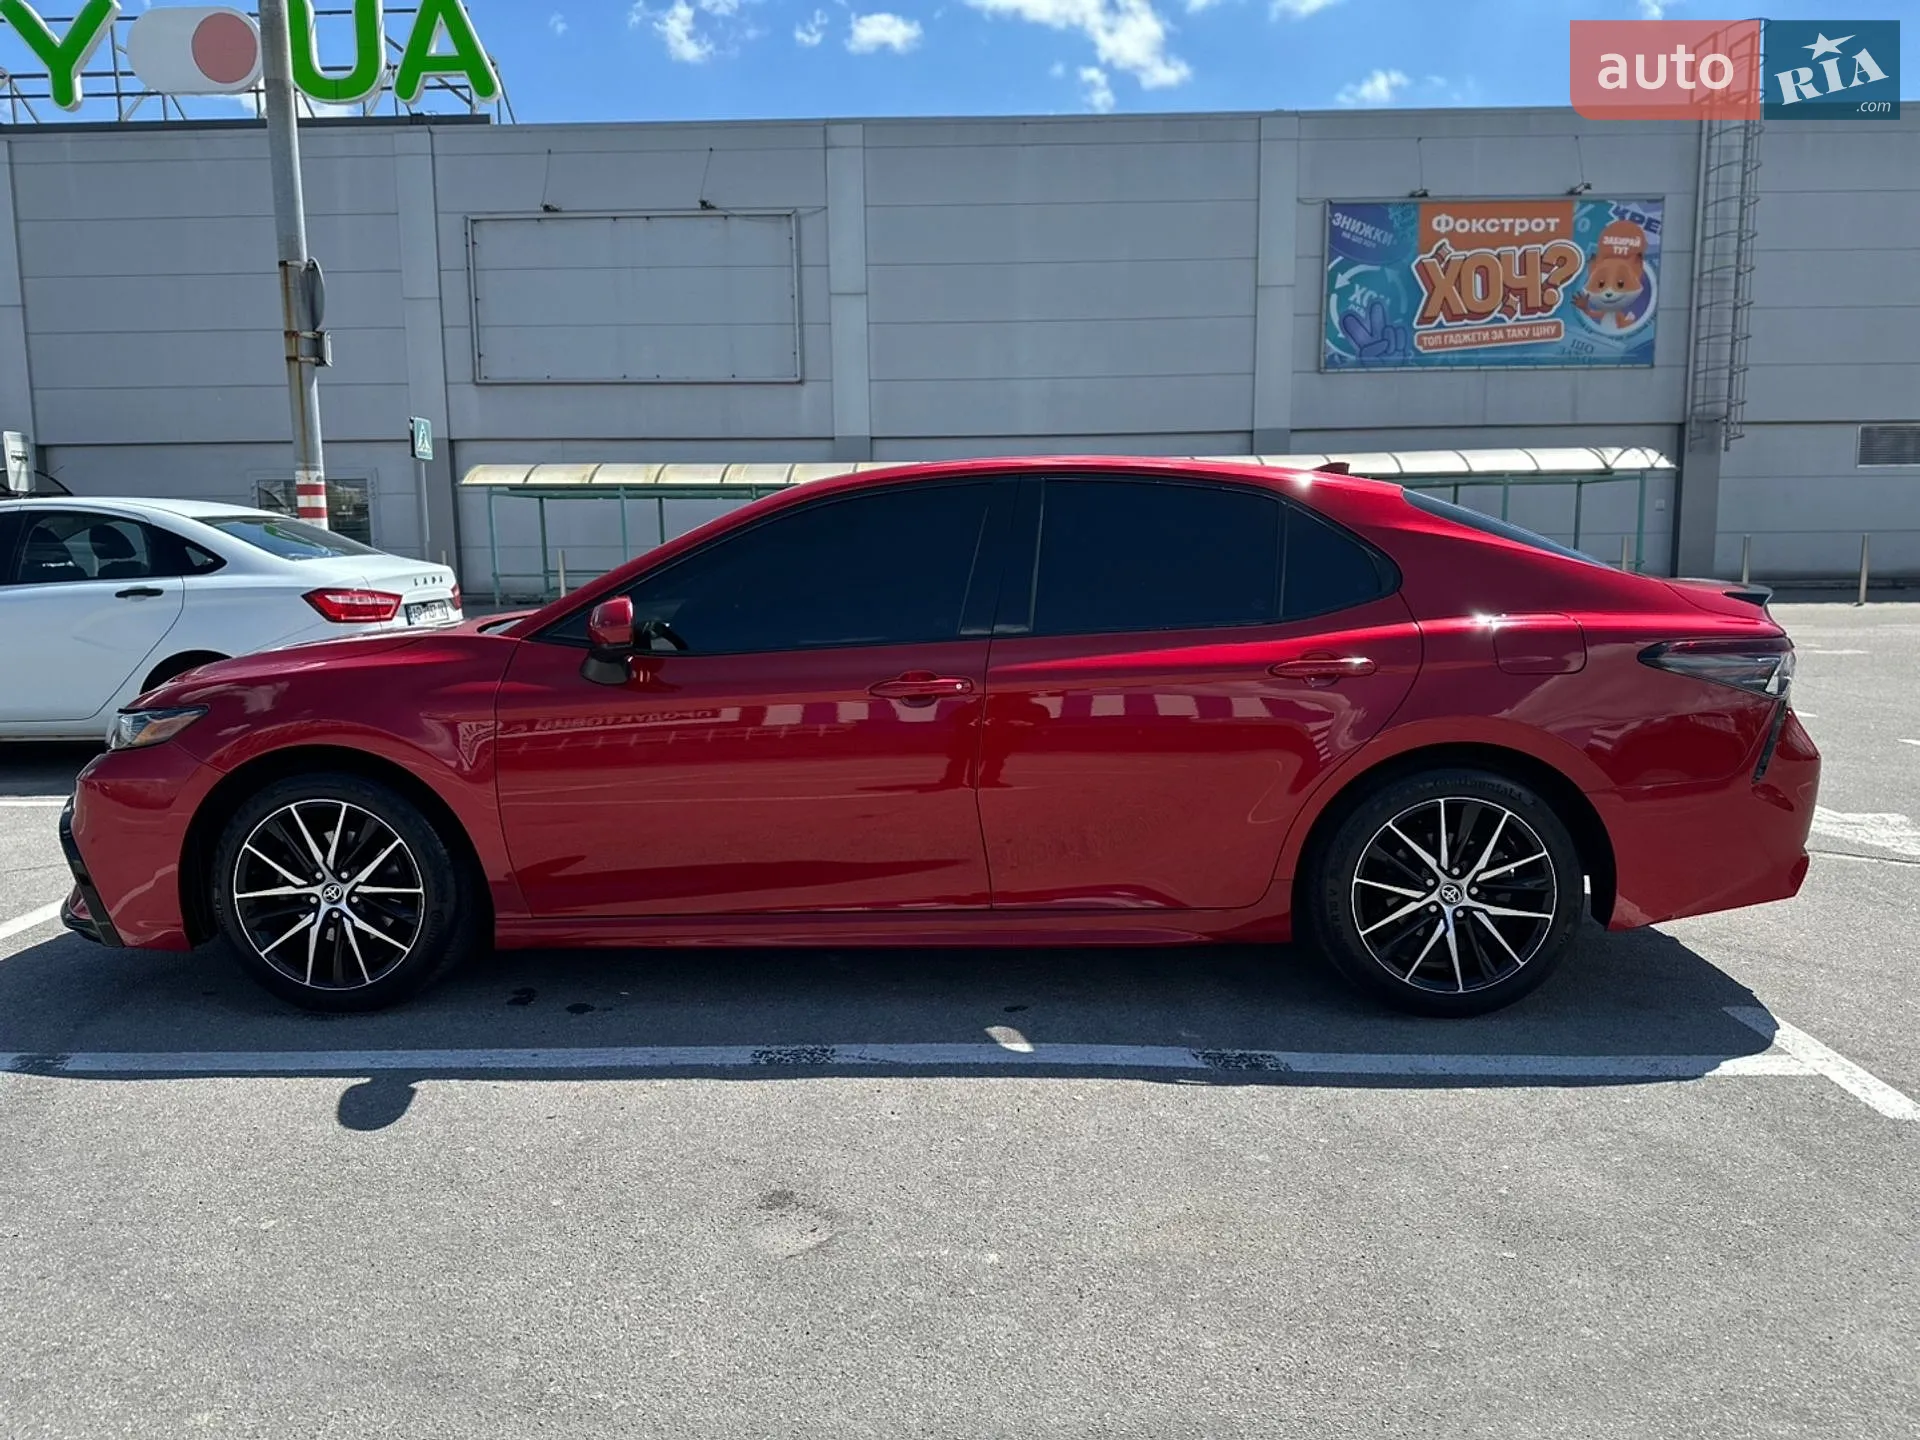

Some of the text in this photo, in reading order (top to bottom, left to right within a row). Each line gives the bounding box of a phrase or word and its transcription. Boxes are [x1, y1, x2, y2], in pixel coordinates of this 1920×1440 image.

[1332, 212, 1393, 247] ЗНИЖКИ
[1431, 213, 1560, 236] Фокстрот
[1612, 245, 1629, 255] ТУТ
[1416, 241, 1582, 325] ХОЧ?
[1422, 325, 1557, 347] ТОП ГАДЖЕТИ ЗА ТАКУ ЦІНУ
